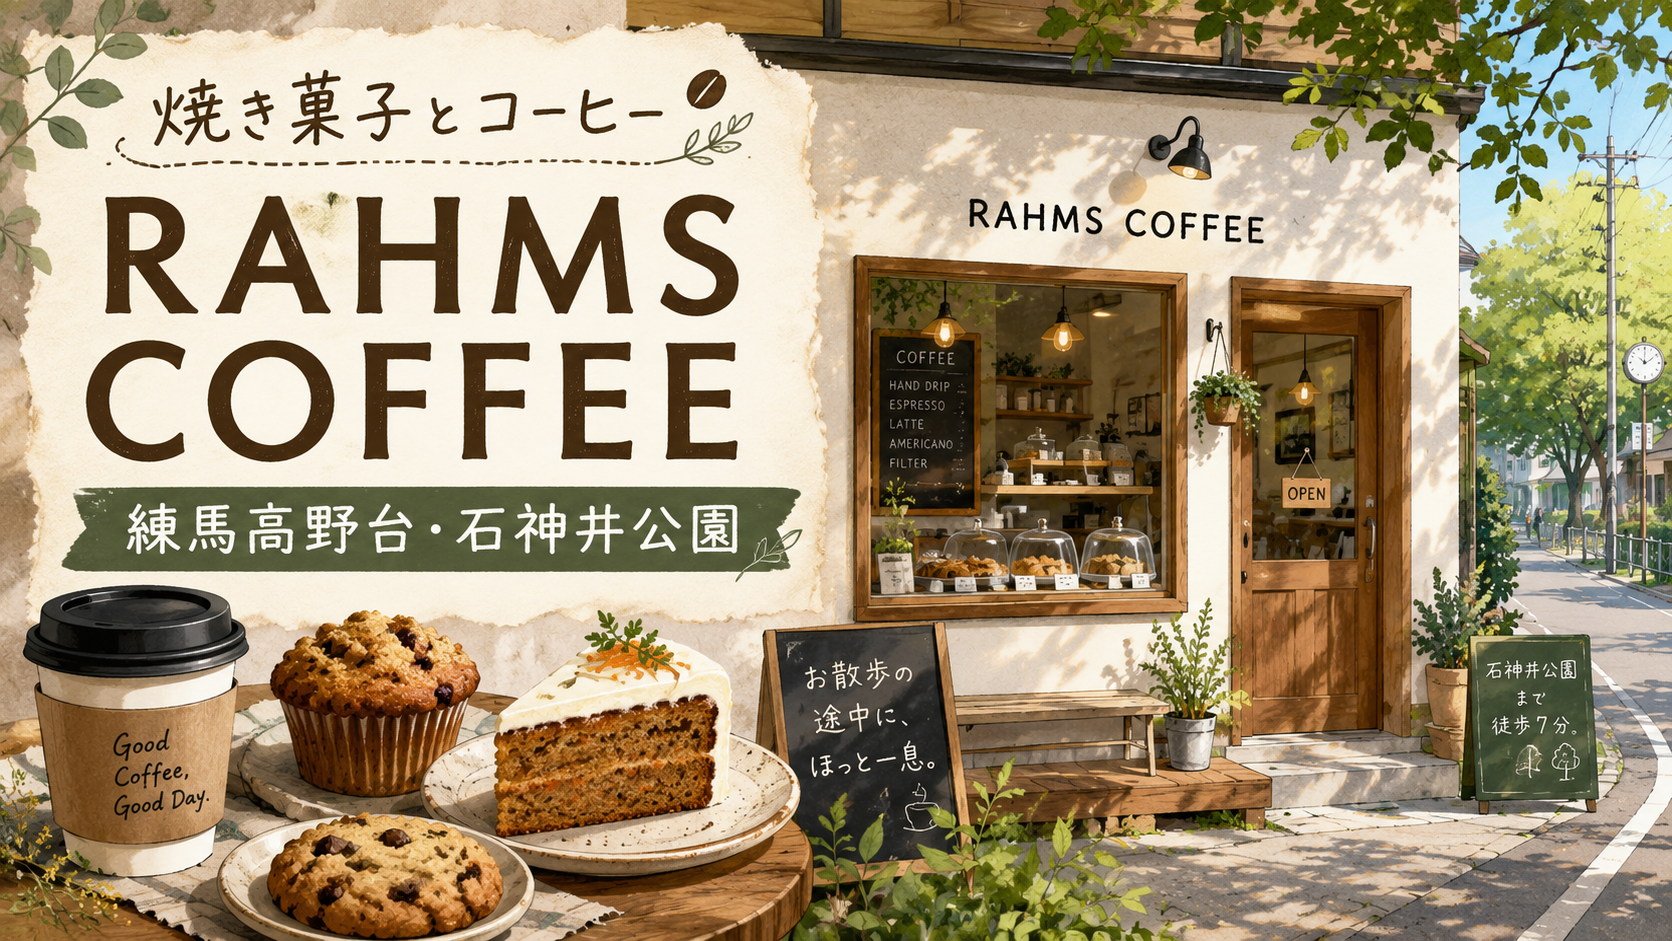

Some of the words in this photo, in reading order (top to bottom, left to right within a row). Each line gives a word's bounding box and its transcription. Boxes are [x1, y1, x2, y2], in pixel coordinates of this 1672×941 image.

[969, 198, 1103, 235] RAHMS
[1125, 208, 1264, 244] COFFEE
[896, 350, 955, 365] COFFEE
[889, 380, 920, 391] HAND
[925, 380, 950, 392] DRIP
[889, 399, 945, 411] ESPRESSO
[889, 418, 924, 430] LATTE
[889, 438, 953, 450] AMERICANO
[889, 457, 928, 469] FILTER
[1287, 486, 1326, 501] OPEN
[804, 658, 913, 690] お散歩の
[1486, 660, 1577, 680] 石神井公園
[1517, 690, 1546, 706] まで
[813, 702, 909, 734] 途中に、
[113, 728, 170, 761] Good
[811, 740, 935, 778] ほっと一息。
[114, 761, 189, 789] Coffee,
[114, 791, 164, 821] Good
[172, 789, 210, 813] Day.
